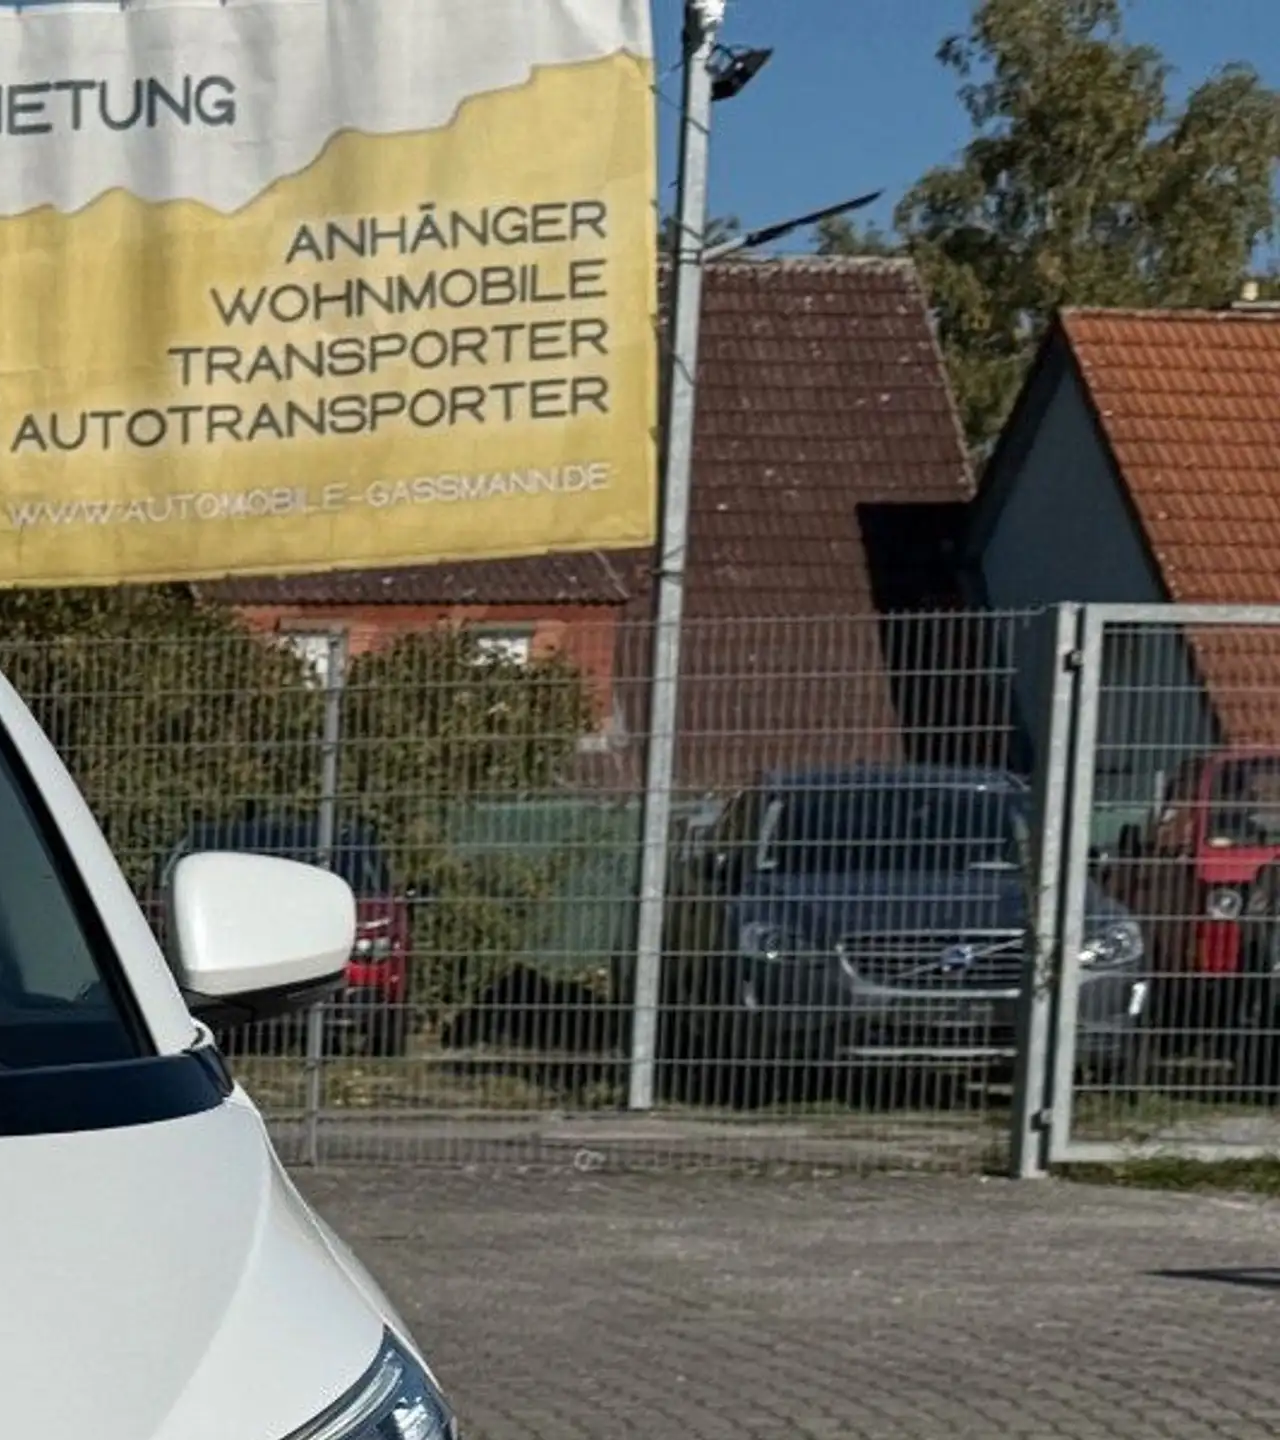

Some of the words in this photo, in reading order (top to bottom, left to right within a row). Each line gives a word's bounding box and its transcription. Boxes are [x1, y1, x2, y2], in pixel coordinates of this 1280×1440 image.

[285, 200, 608, 264] ANHÄNGER
[209, 258, 608, 327] WOHNMOBILE
[167, 317, 609, 386] TRANSPORTER
[10, 375, 609, 453] AUTOTRANSPORTER
